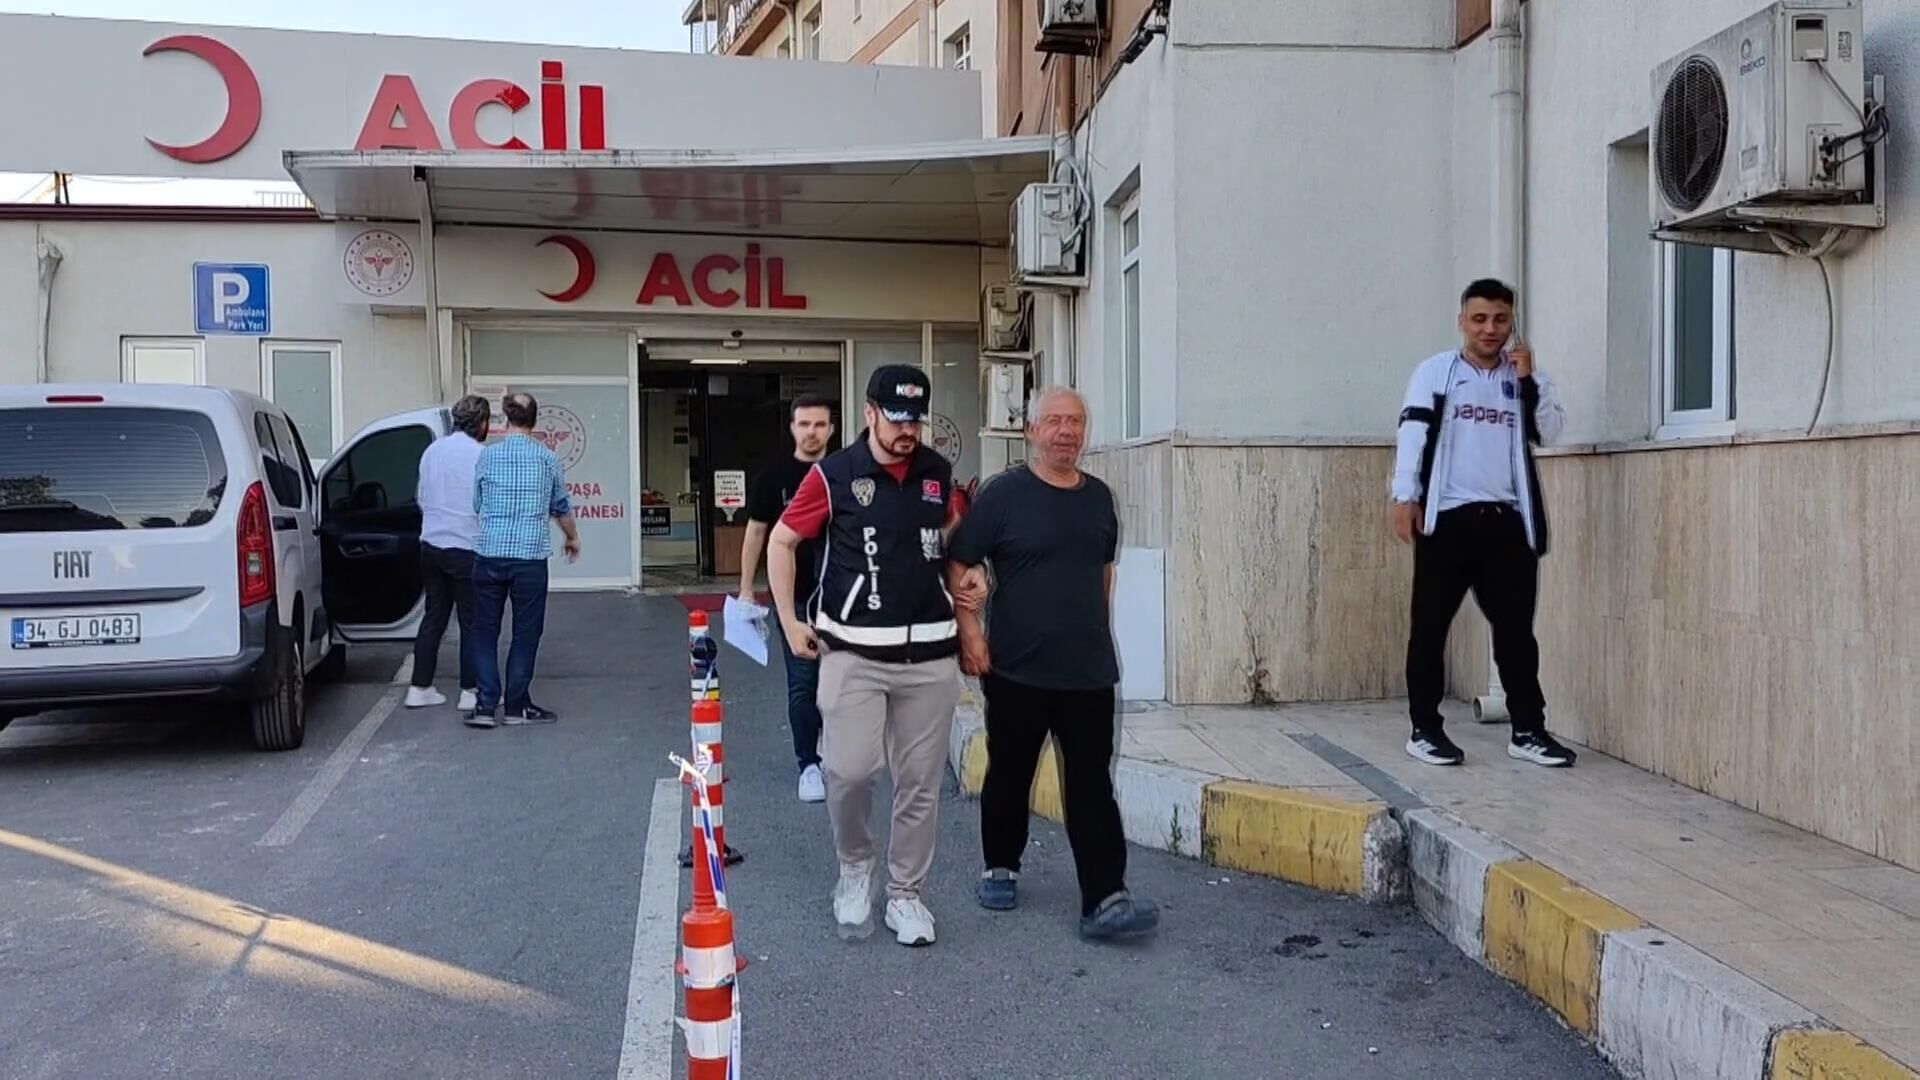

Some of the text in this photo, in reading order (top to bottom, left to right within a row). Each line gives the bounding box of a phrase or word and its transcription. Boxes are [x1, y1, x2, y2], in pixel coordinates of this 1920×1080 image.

[636, 243, 807, 310] ACİL
[213, 273, 250, 324] P
[225, 306, 265, 318] Ambulans
[227, 320, 264, 331] Park Yeri
[54, 551, 92, 578] FIAT
[863, 526, 882, 610] POLİS
[26, 621, 46, 640] 34
[58, 620, 80, 638] GJ
[89, 617, 133, 638] 0483
